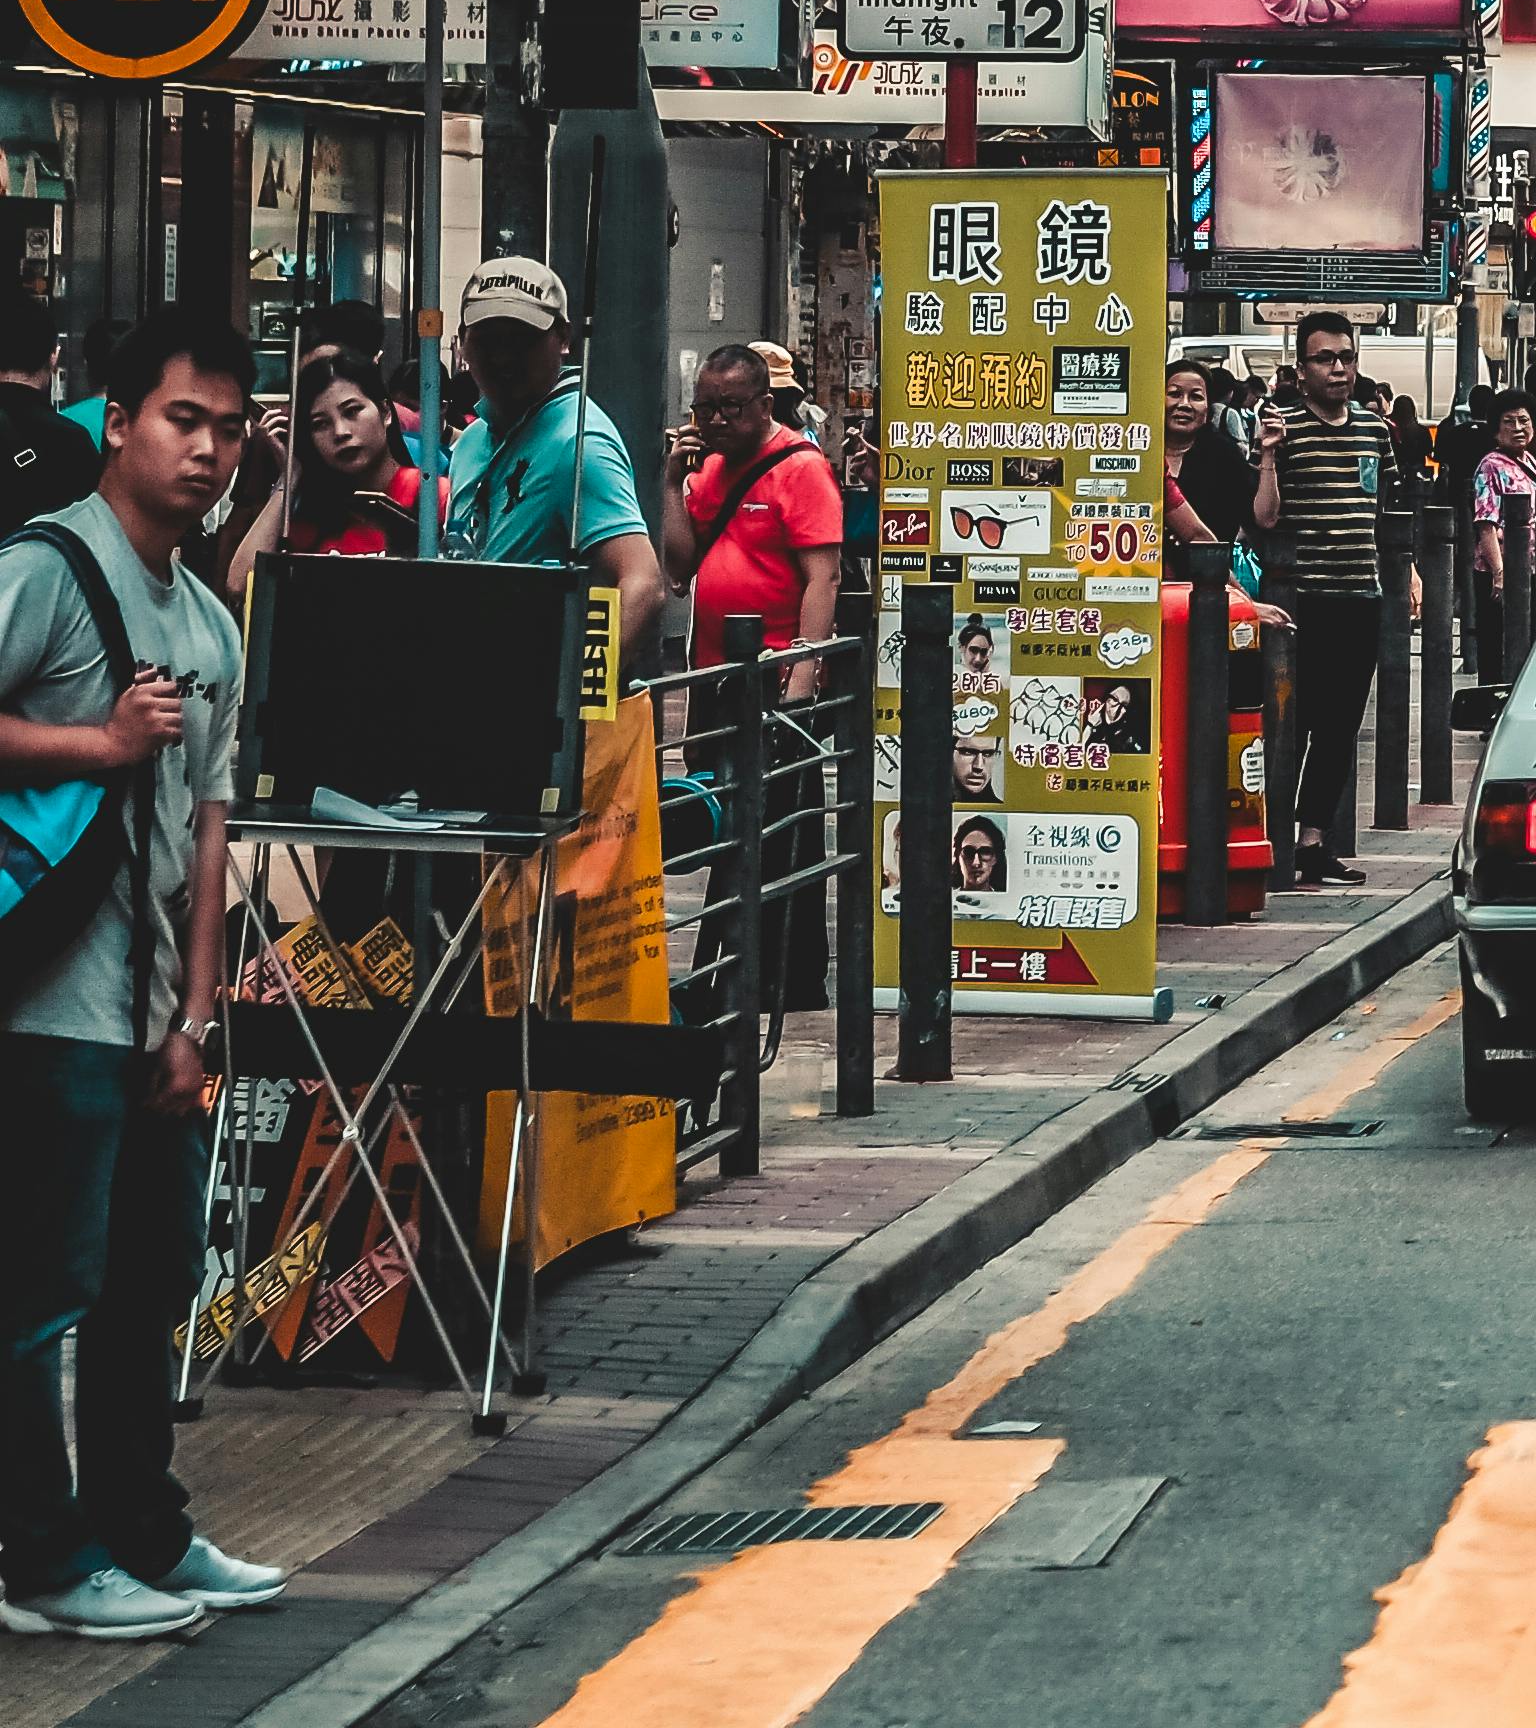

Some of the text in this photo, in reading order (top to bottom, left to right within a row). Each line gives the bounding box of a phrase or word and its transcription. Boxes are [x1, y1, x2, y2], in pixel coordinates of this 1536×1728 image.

[272, 25, 412, 41] Wing Shing Photo
[884, 16, 952, 48] 午夜
[928, 200, 1112, 285] 眼鏡
[477, 275, 543, 301] CATERPILLAR
[905, 292, 1134, 336] 驗配中心
[906, 351, 1048, 410] 歡迎預約
[884, 453, 936, 482] Dior
[950, 463, 991, 477] BOSS
[1065, 522, 1087, 540] UP
[1089, 522, 1139, 564] 50
[1065, 545, 1087, 561] TO
[1140, 551, 1159, 563] off
[881, 576, 900, 602] ck
[1033, 587, 1083, 602] GUCCI
[1005, 608, 1103, 635] 學生套餐
[1026, 825, 1091, 849] 全視線
[1023, 850, 1096, 867] Transitions
